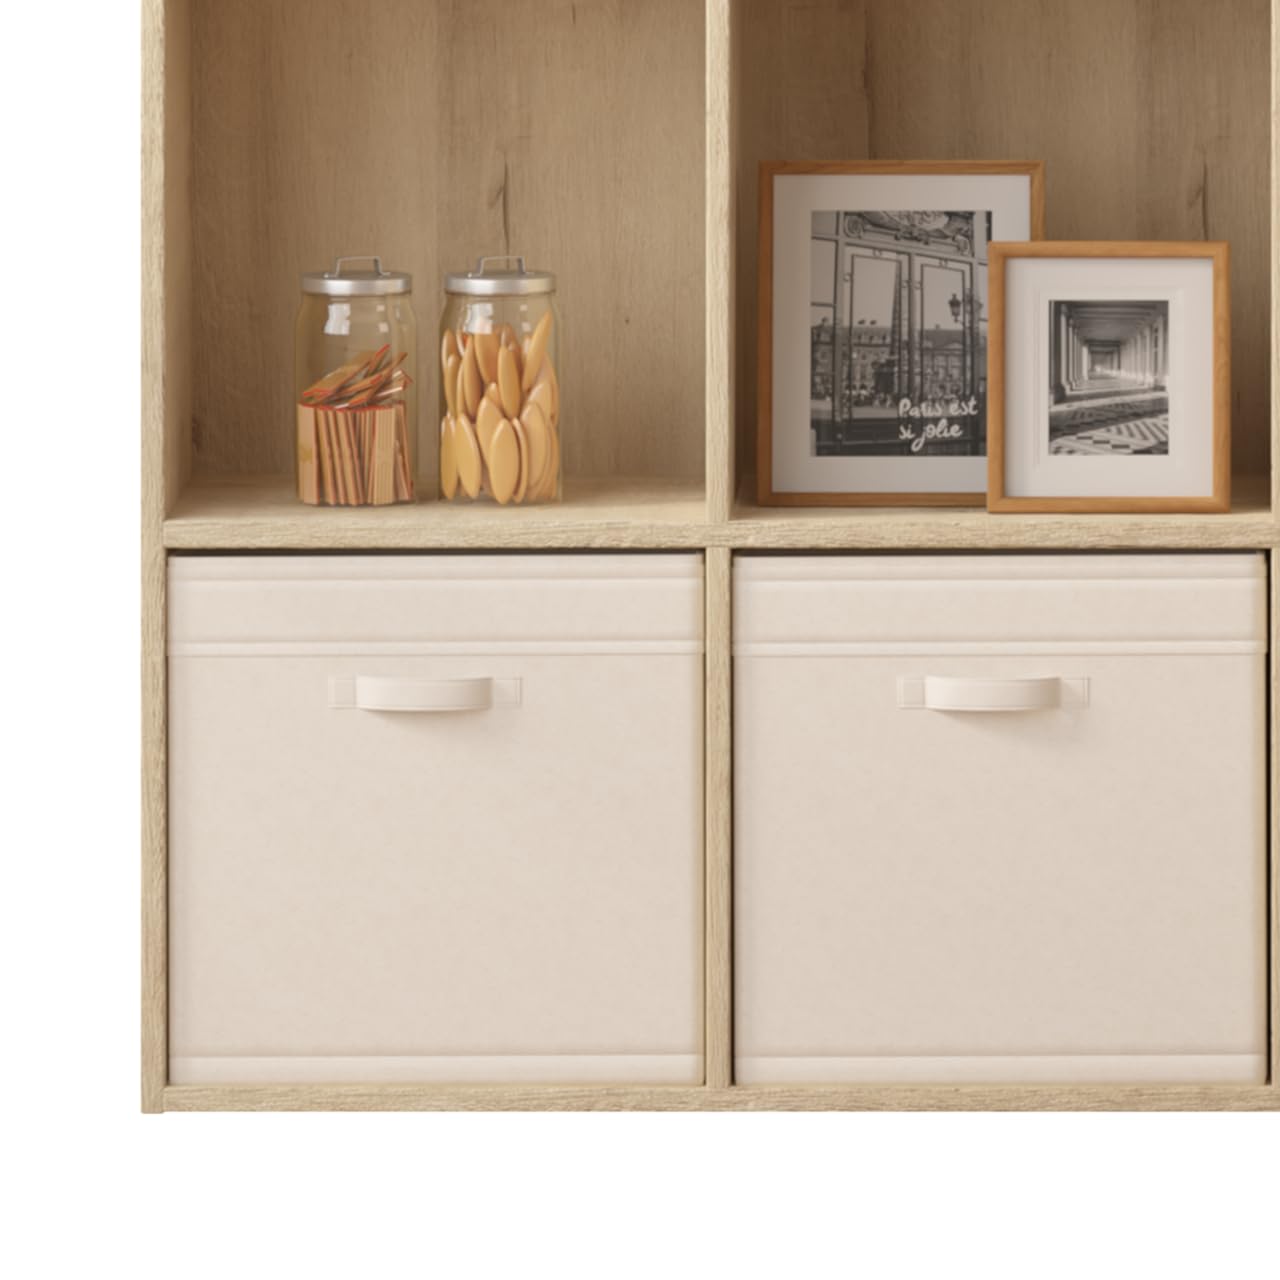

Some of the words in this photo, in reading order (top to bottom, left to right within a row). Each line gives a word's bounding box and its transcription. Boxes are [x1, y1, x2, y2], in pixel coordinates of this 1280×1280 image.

[898, 394, 942, 417] Paris
[948, 395, 979, 416] est
[898, 423, 916, 440] si
[910, 418, 964, 453] jolie
